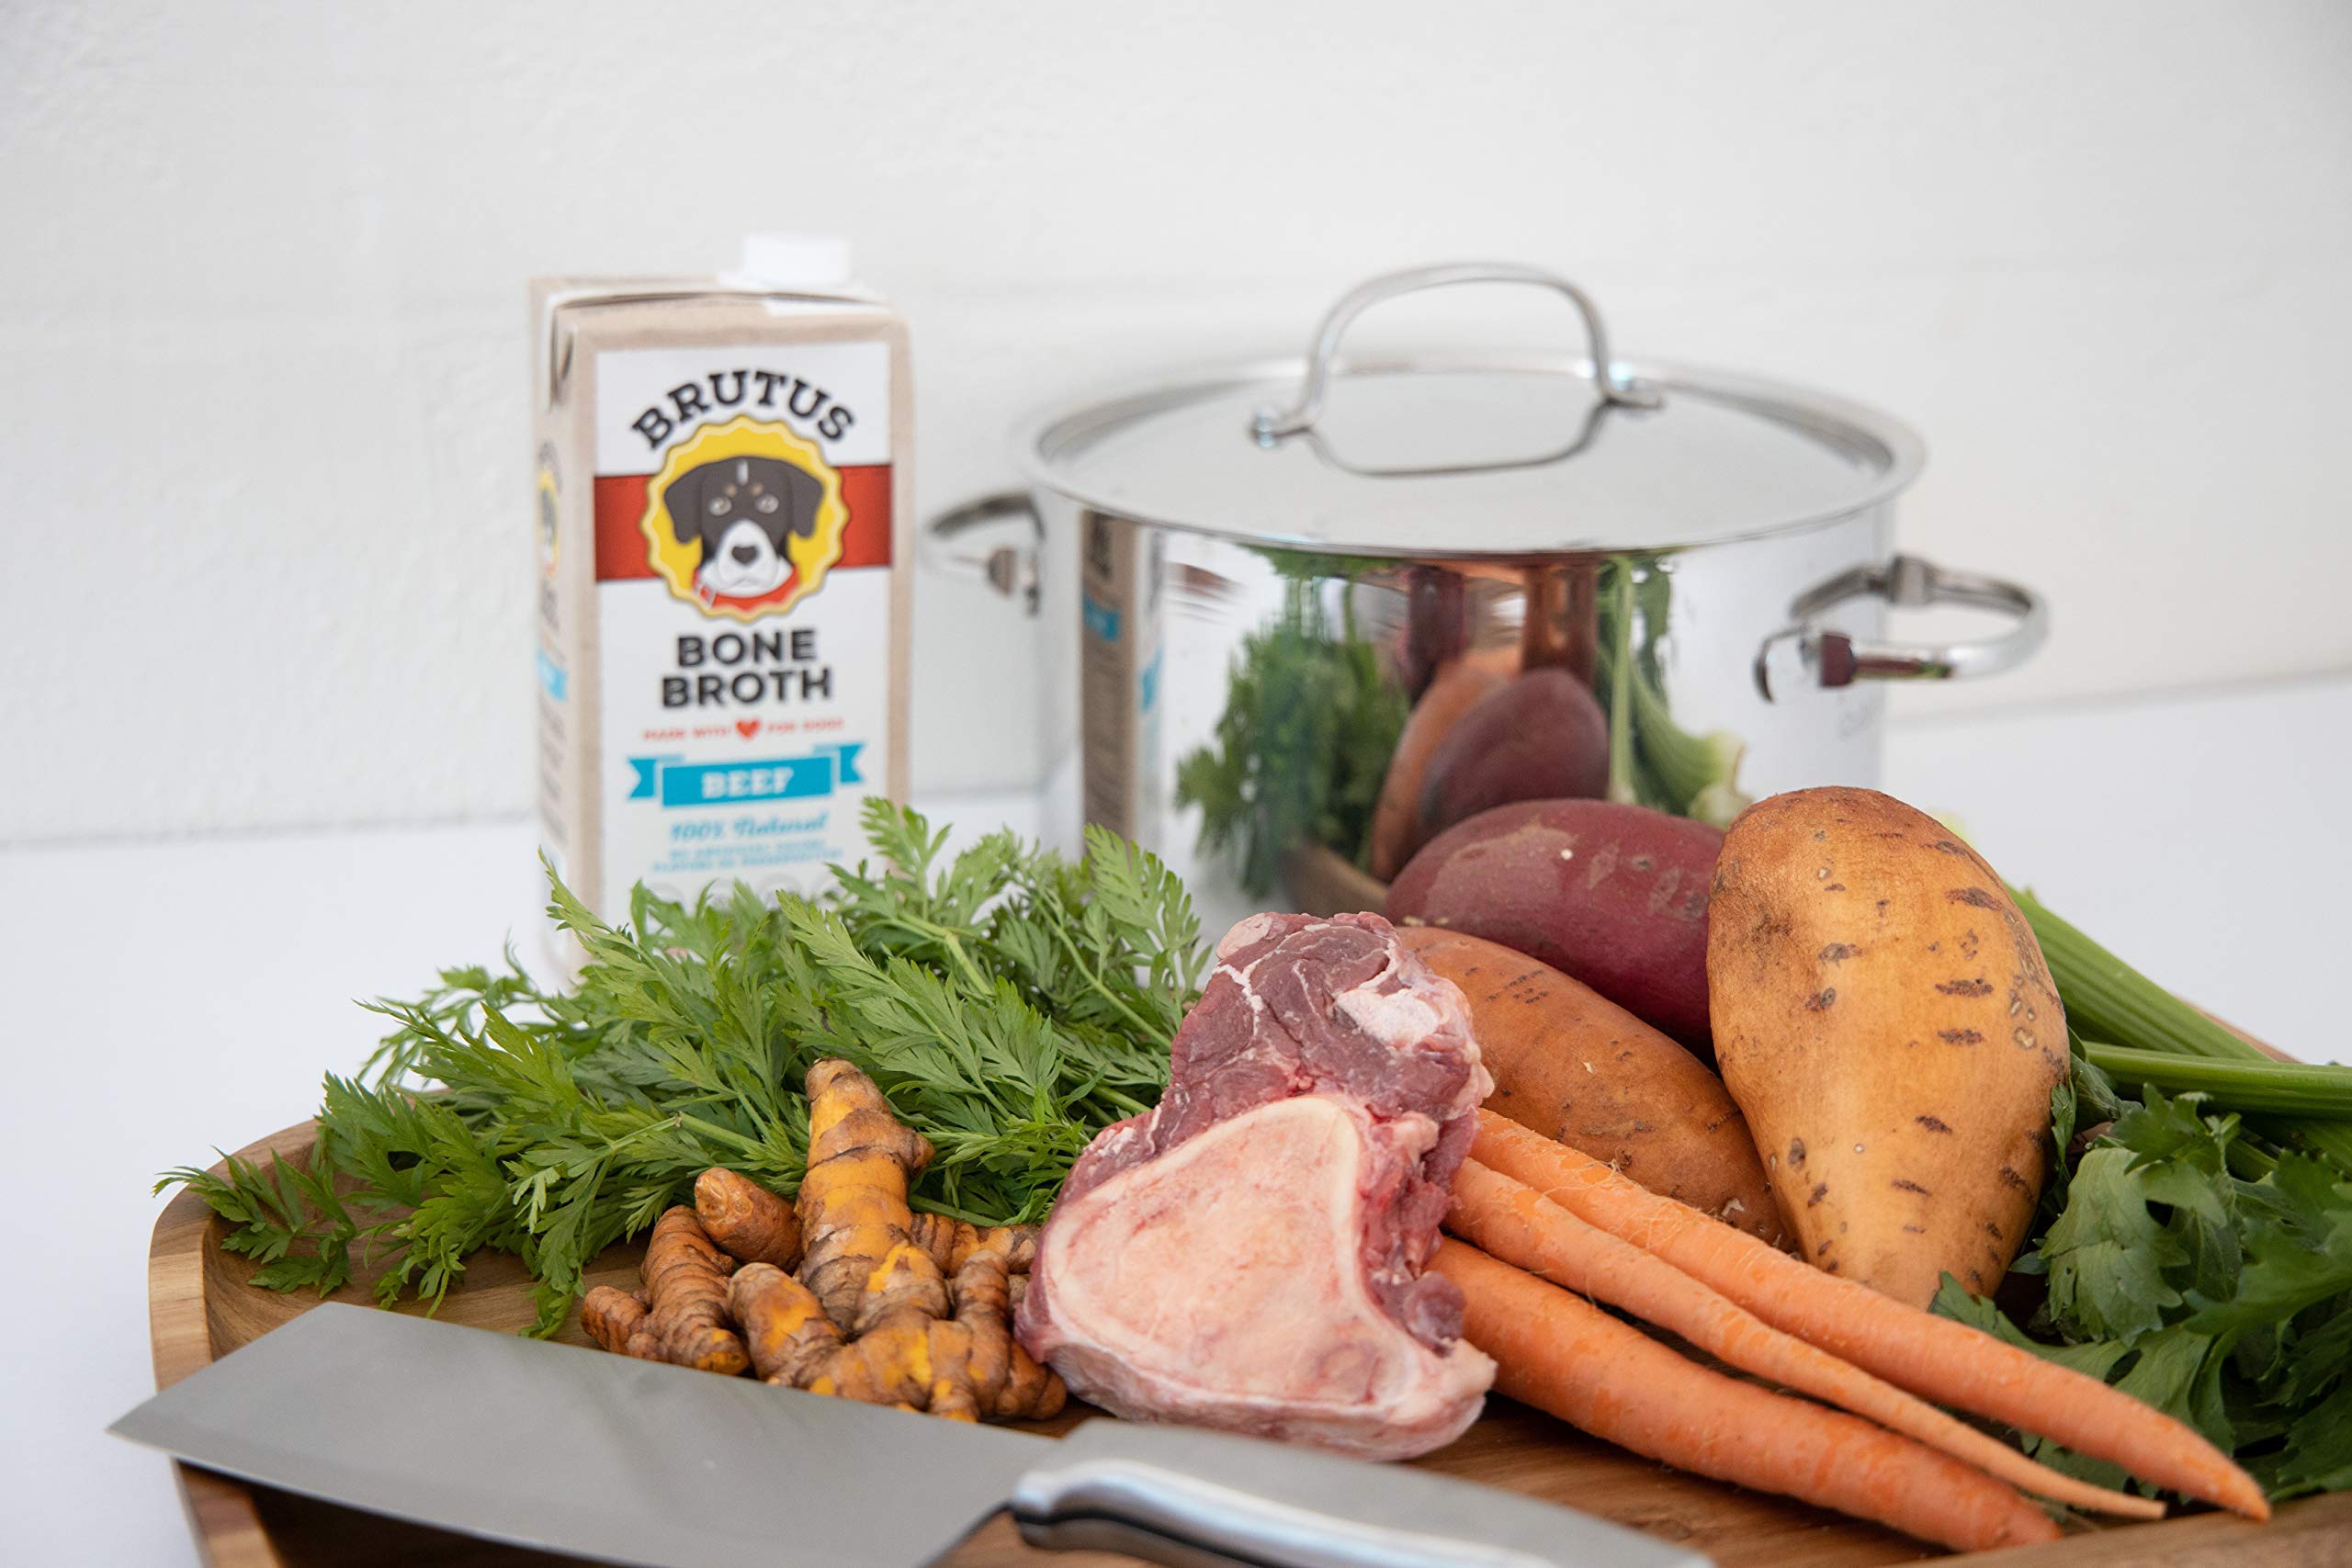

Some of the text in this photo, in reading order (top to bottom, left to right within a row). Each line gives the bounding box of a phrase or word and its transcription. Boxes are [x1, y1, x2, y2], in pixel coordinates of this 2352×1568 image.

[630, 369, 854, 449] BRUTUS
[676, 628, 816, 668] BONE
[662, 668, 831, 708] BROTH
[702, 766, 794, 798] BEEF
[733, 812, 830, 835] Natural
